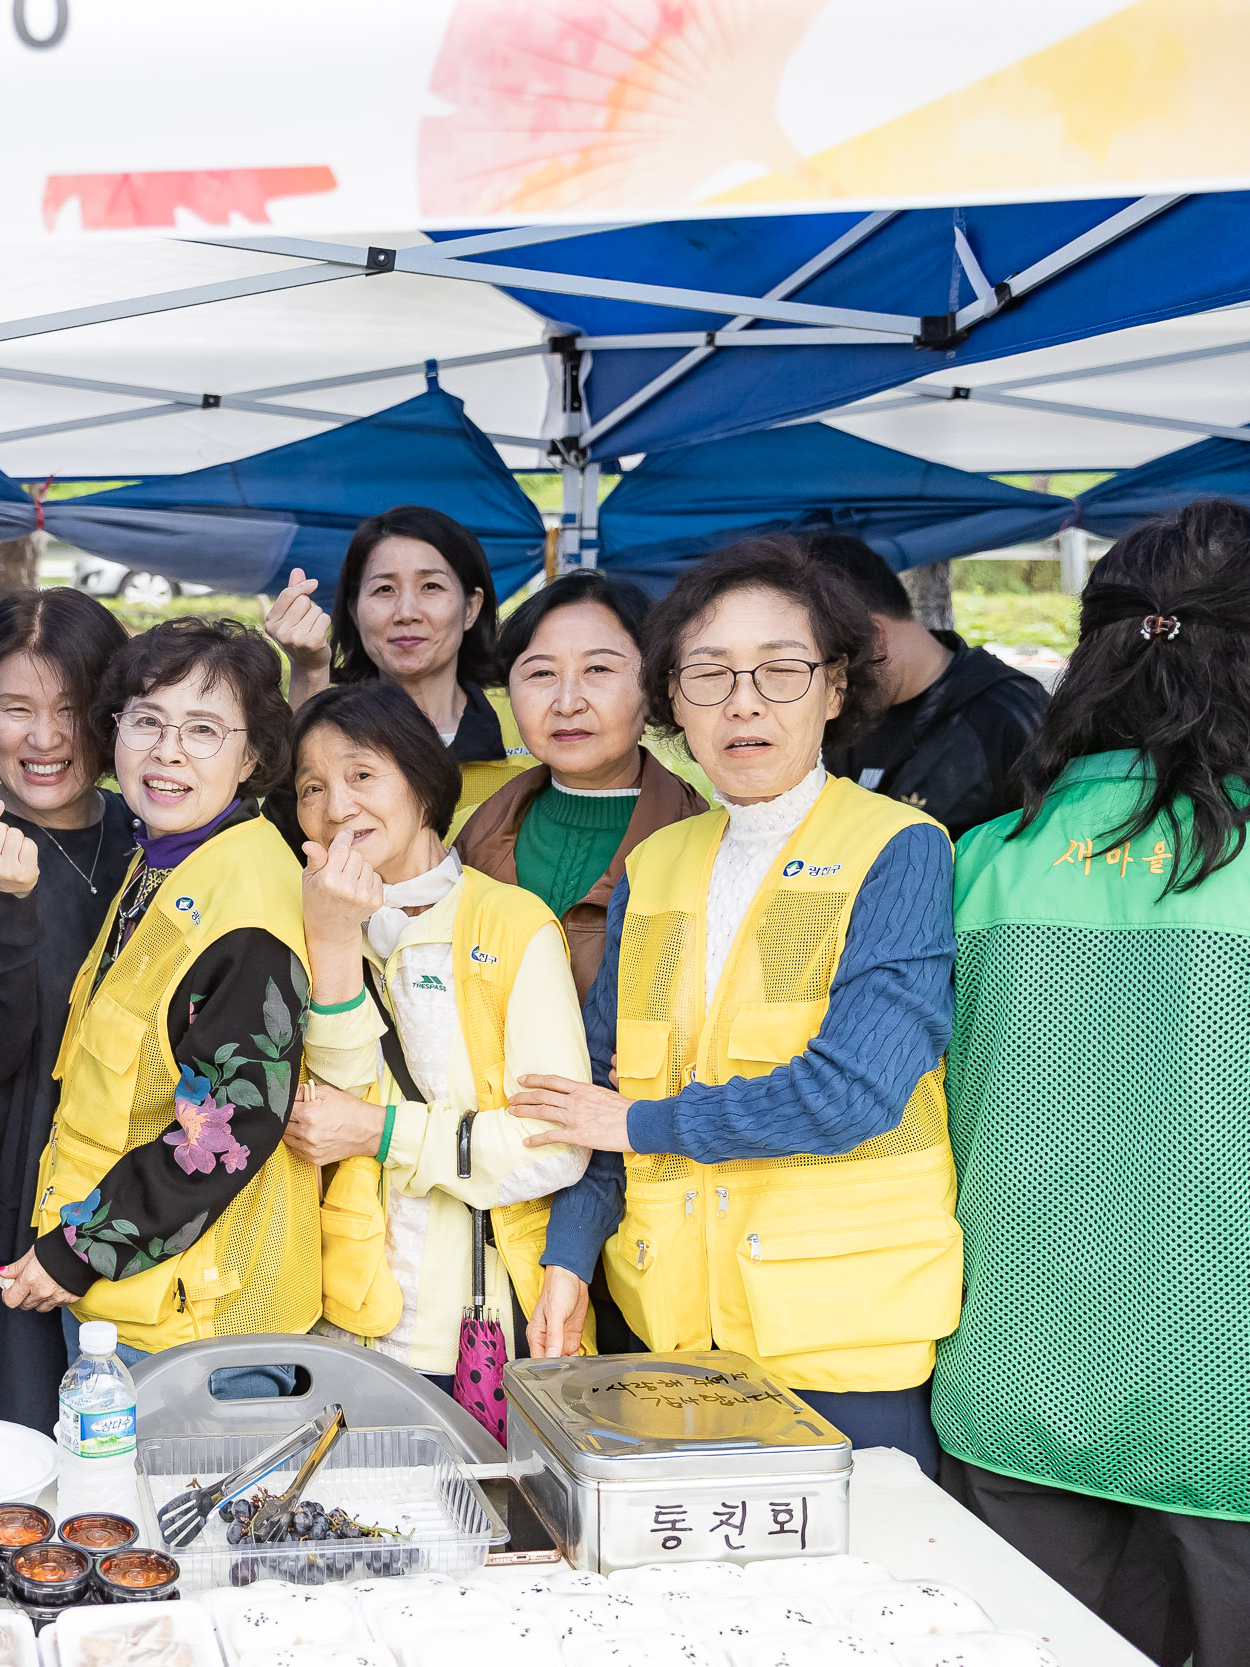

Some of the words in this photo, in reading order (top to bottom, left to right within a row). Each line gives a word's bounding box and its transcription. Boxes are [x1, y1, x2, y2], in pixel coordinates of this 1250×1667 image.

[1052, 838, 1174, 878] 새마을
[806, 864, 841, 877] 광진구
[478, 952, 498, 965] 진구
[605, 1378, 684, 1398] 사랑해
[102, 1416, 131, 1433] 삼다수
[650, 1496, 808, 1550] 통친회
